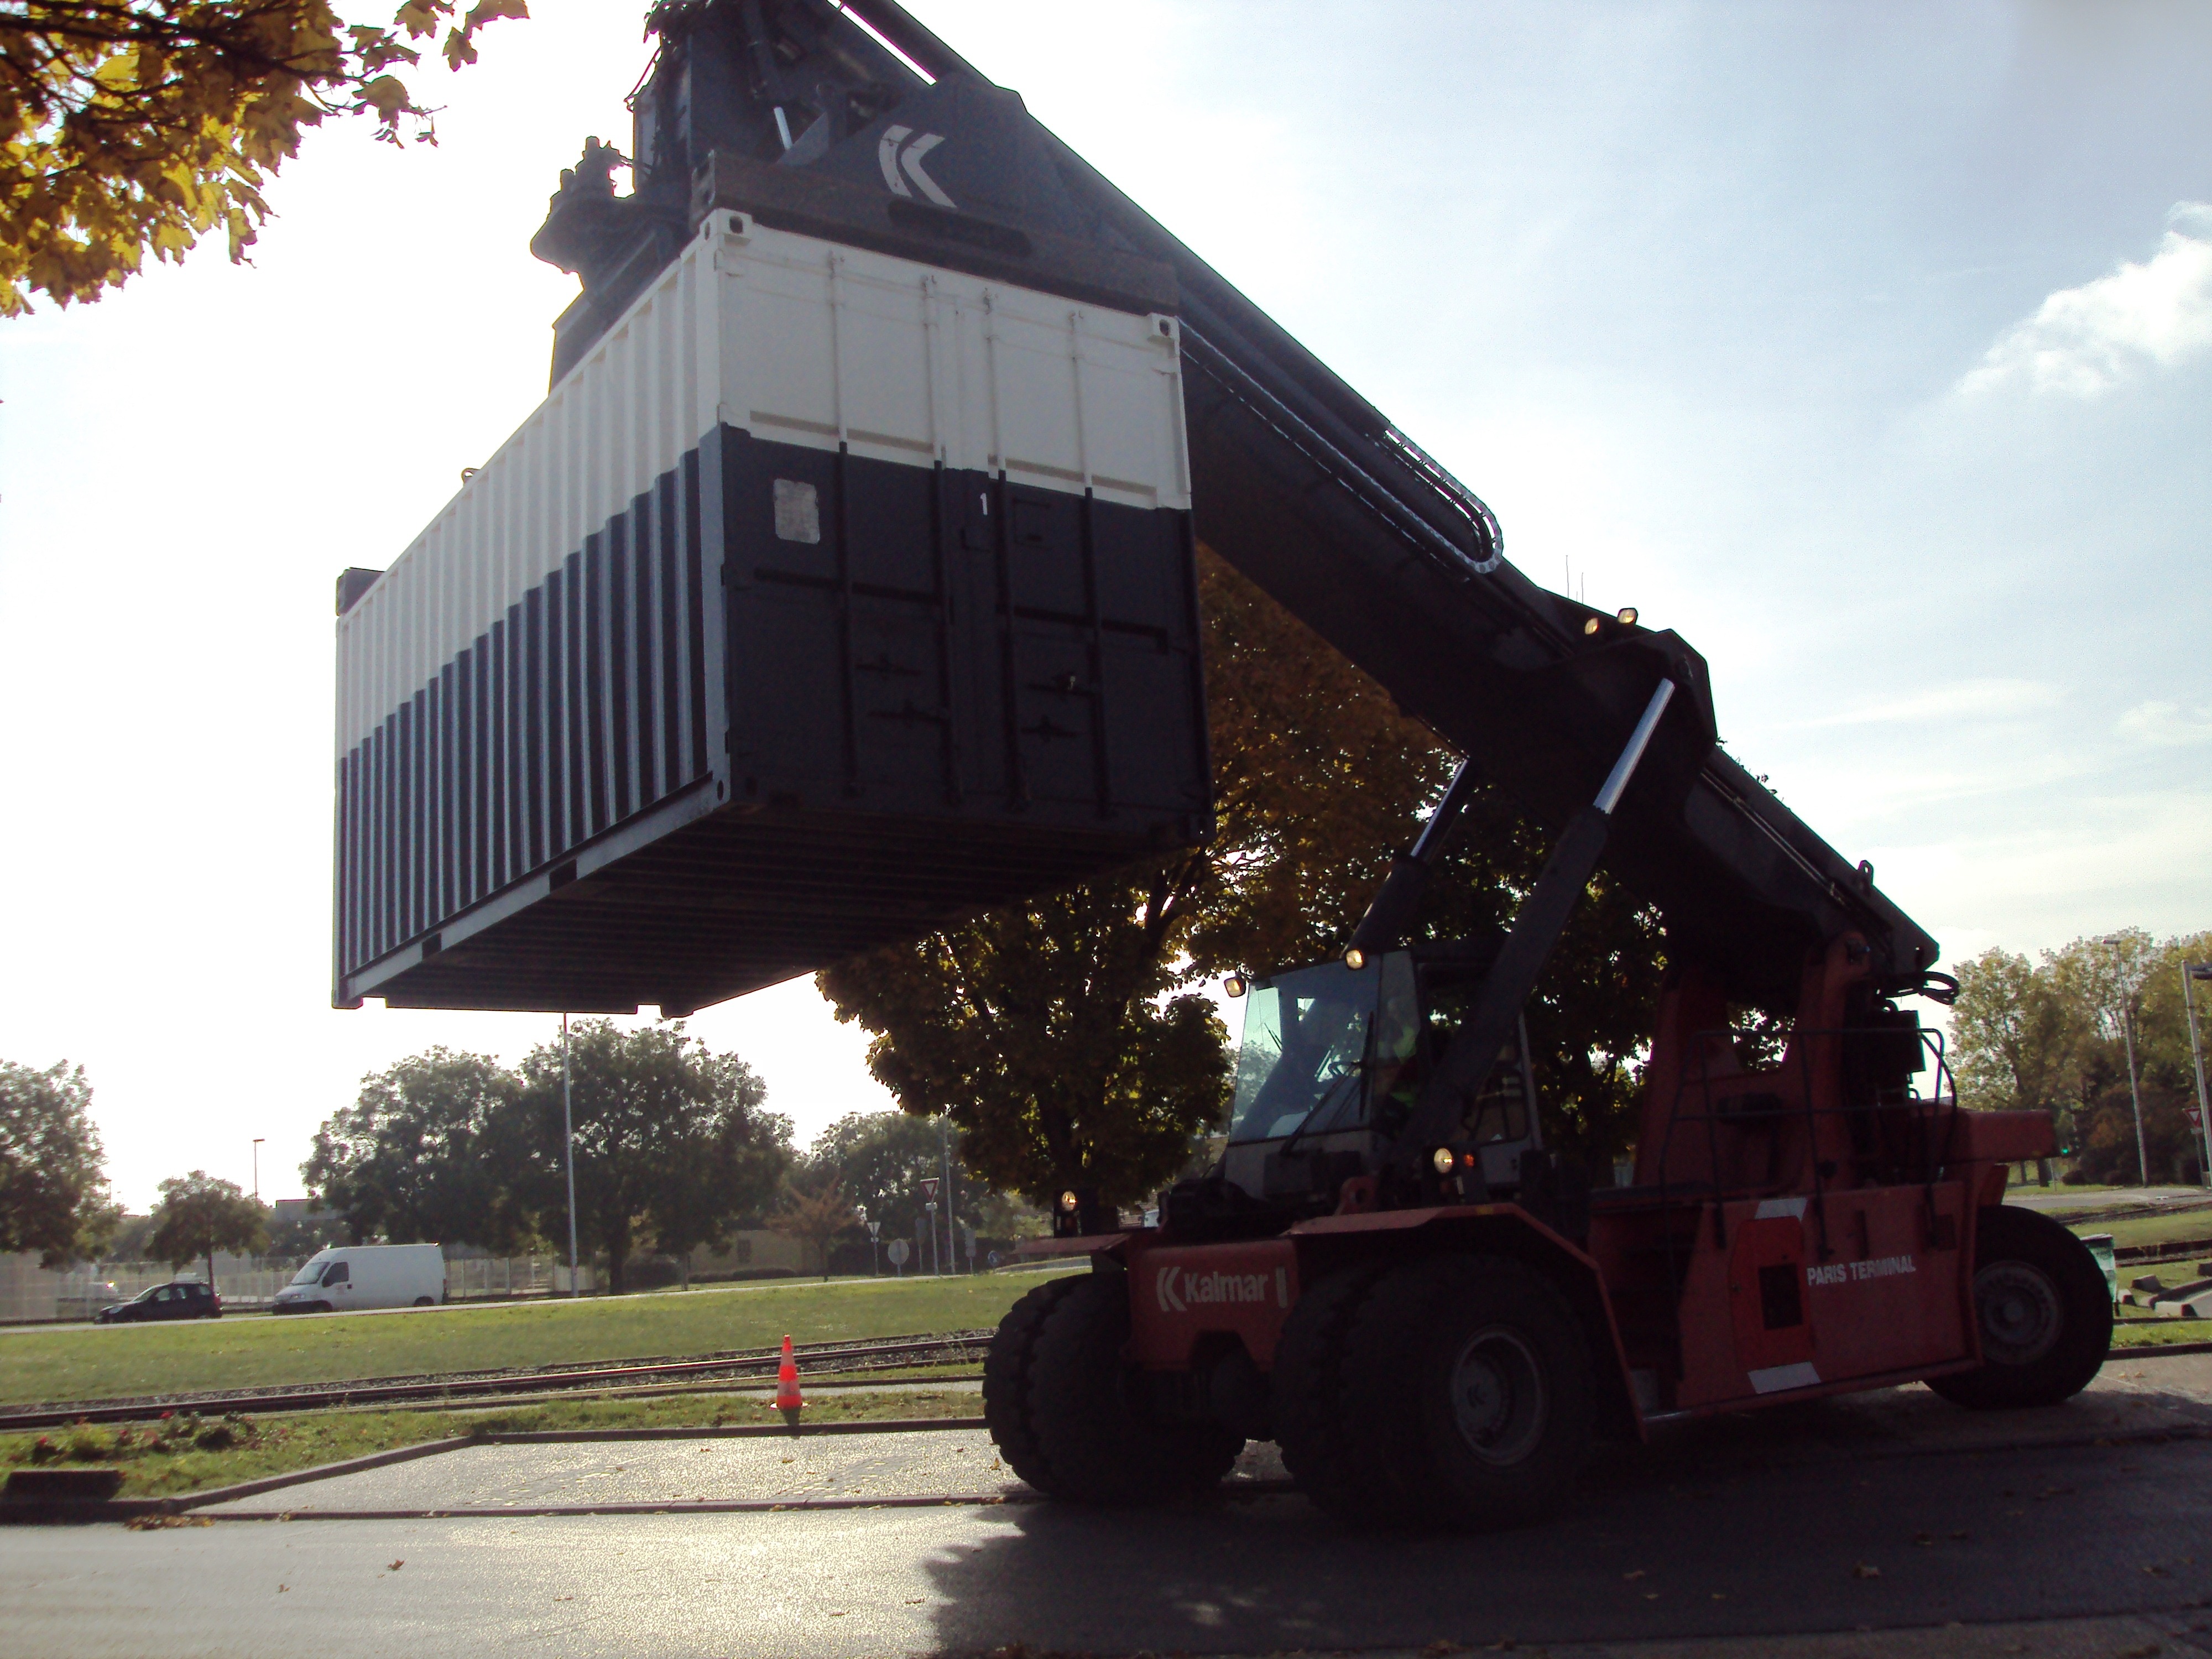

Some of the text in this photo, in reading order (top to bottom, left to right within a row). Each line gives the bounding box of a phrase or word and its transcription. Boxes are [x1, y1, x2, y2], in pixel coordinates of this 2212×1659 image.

[1184, 1271, 1269, 1303] Kalmar
[1806, 1255, 1917, 1287] PARIS TERMINAL
